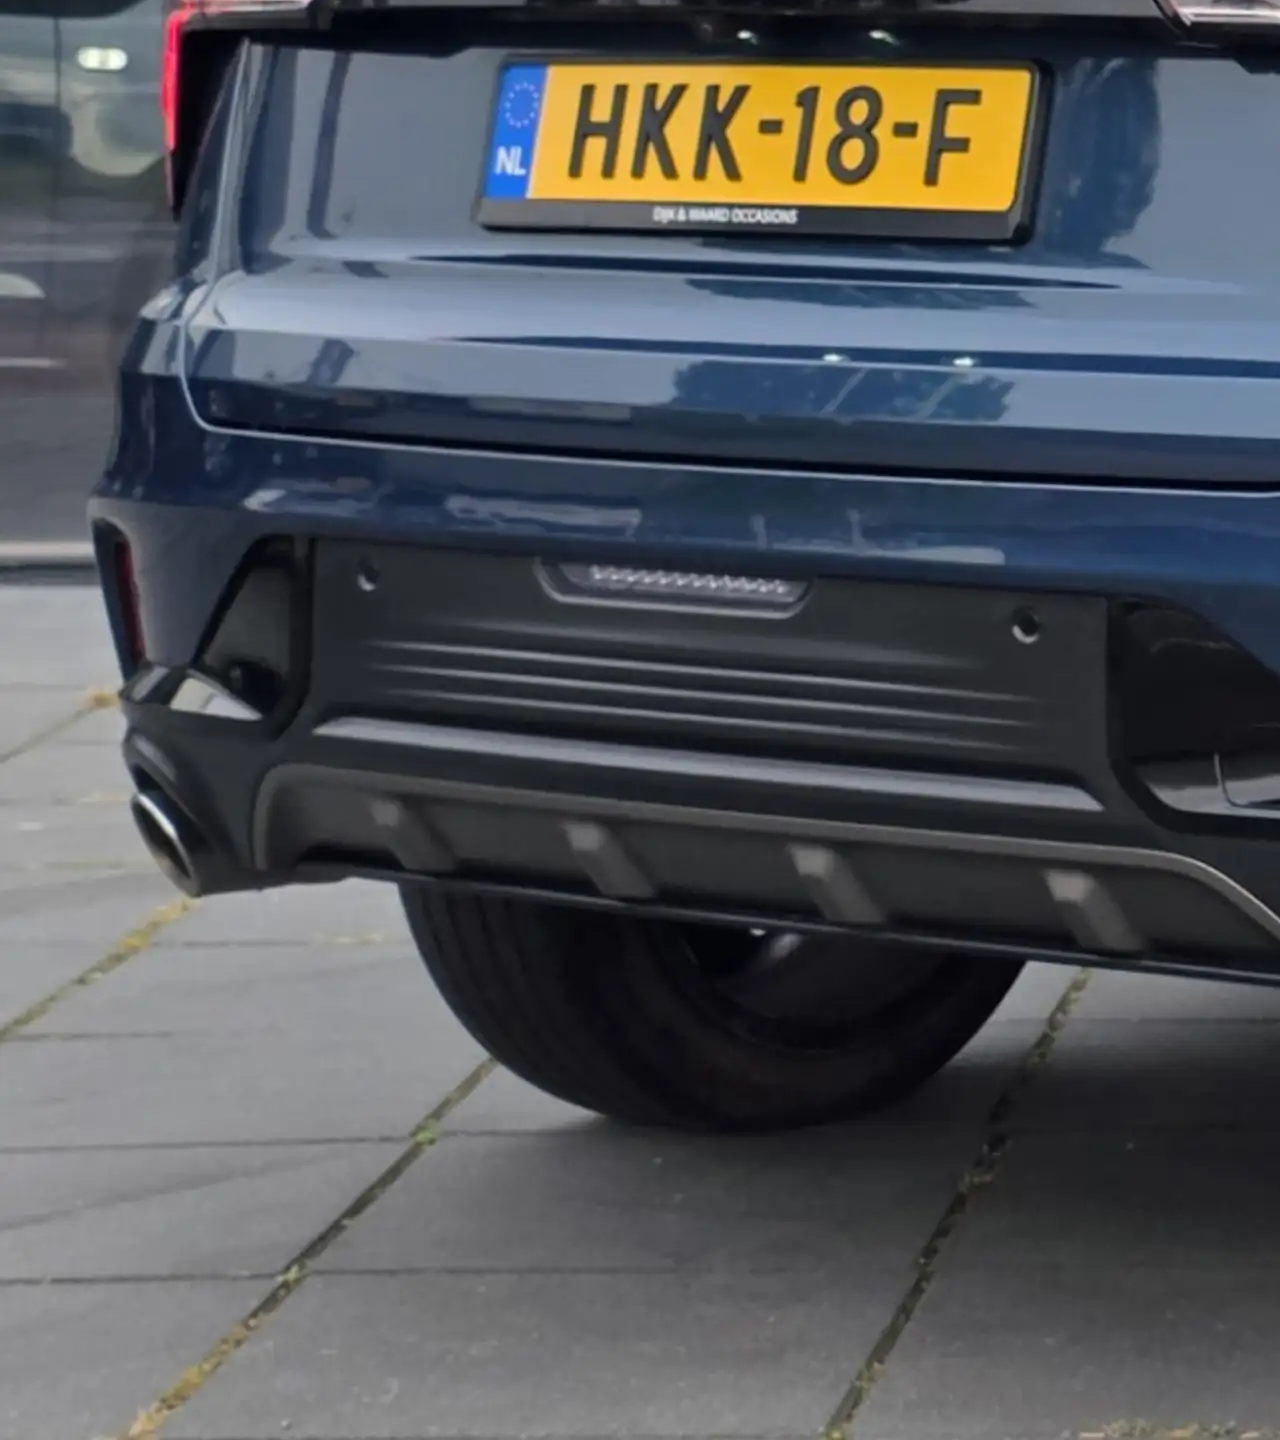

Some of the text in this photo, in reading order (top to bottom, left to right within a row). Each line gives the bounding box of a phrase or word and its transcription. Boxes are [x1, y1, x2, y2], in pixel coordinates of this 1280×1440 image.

[567, 82, 983, 187] HKK-18-F
[495, 145, 527, 176] NL
[731, 208, 799, 225] OCCASIONS
